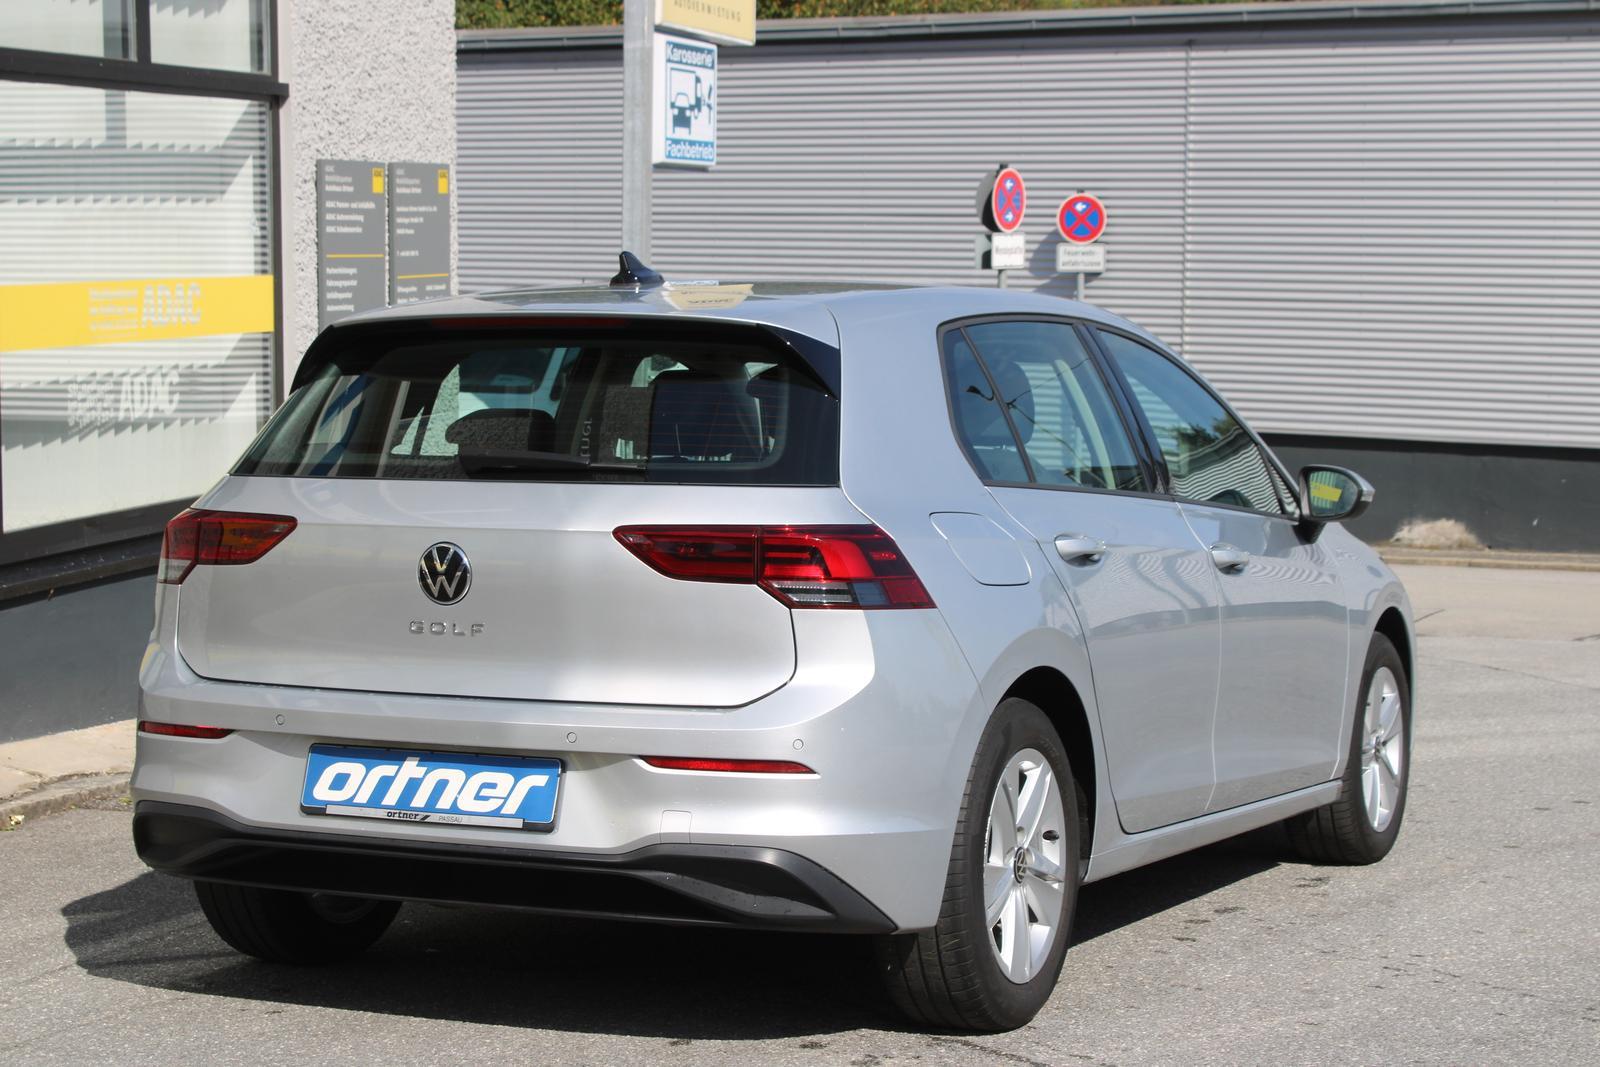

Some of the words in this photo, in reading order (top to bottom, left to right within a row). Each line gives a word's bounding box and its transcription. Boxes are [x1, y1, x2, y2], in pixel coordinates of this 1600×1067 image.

[666, 44, 712, 67] Karosserie
[666, 140, 714, 160] Fachbetrieb
[142, 282, 201, 328] ADAC
[409, 620, 485, 637] GOLF
[312, 757, 549, 815] ortner
[386, 810, 420, 821] ortner
[438, 815, 463, 824] PASSAU
